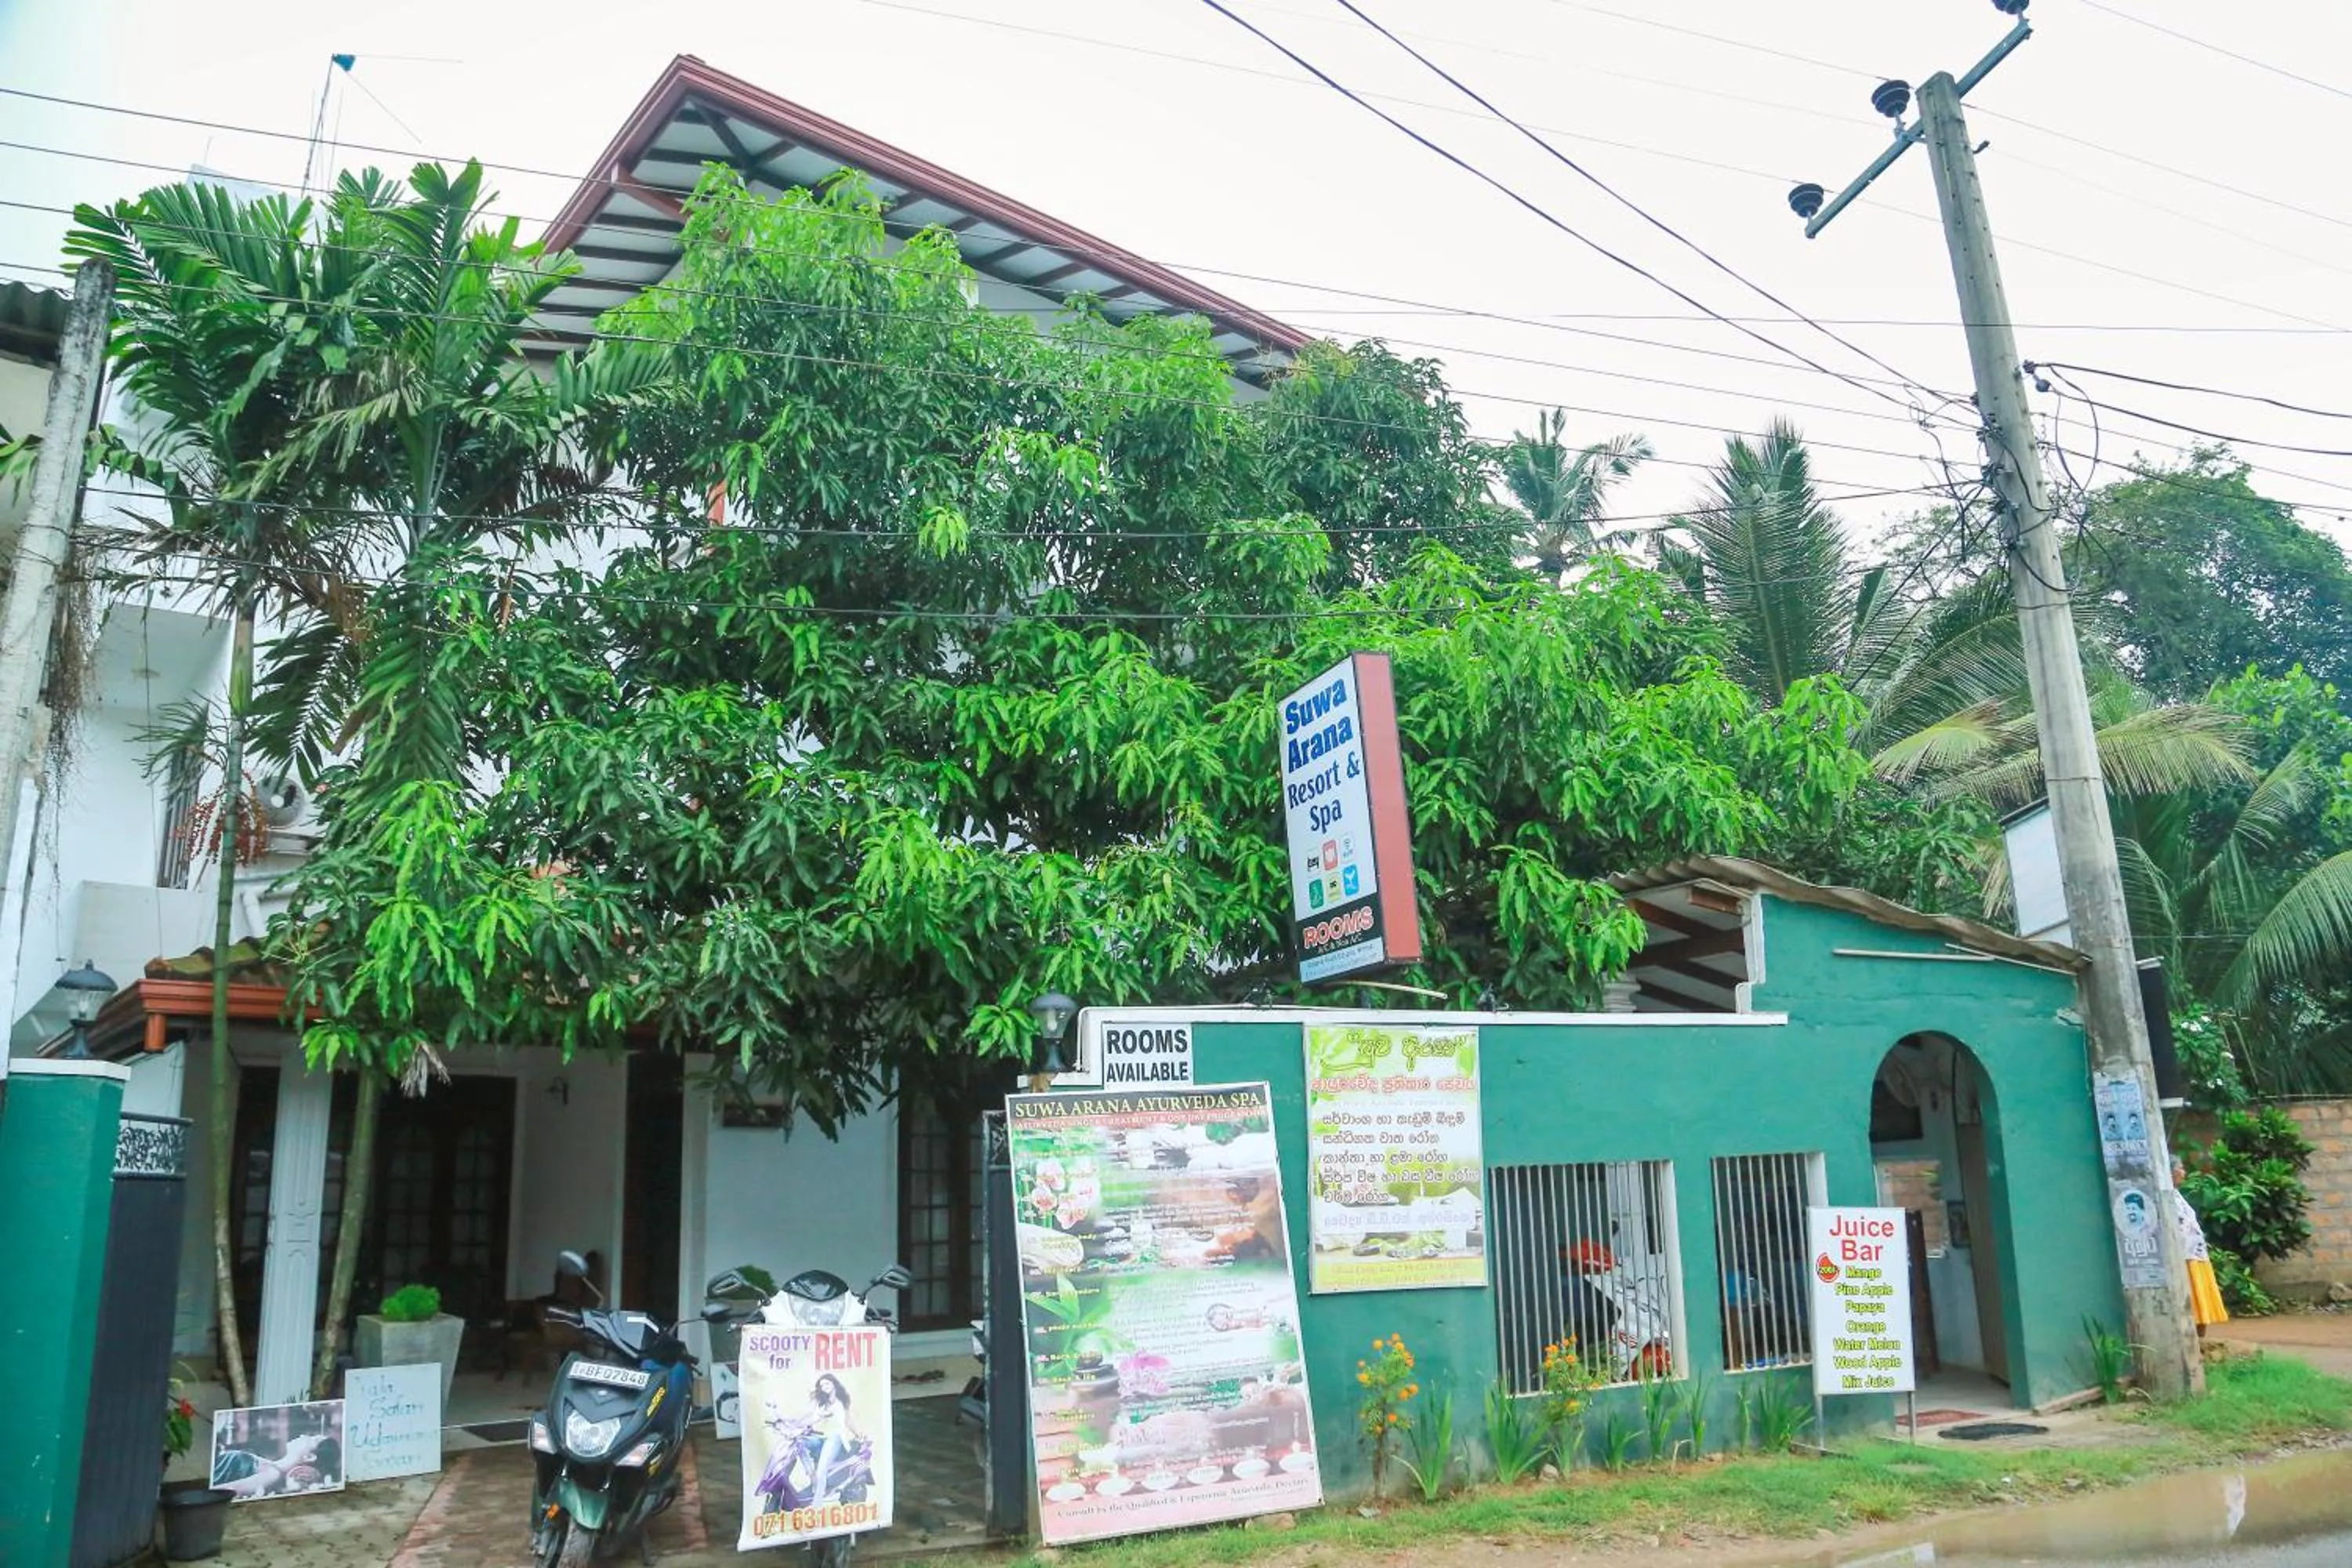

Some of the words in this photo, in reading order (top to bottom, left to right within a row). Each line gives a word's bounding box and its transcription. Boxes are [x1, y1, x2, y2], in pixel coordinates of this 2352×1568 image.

[1285, 678, 1347, 735] Suwa
[1288, 714, 1354, 773] Arana
[1287, 763, 1341, 809] Resort
[1346, 751, 1360, 779] &
[1310, 797, 1342, 835] Spa
[1303, 906, 1374, 949] ROOMS
[1107, 1029, 1188, 1054] ROOMS
[1106, 1062, 1189, 1083] AVAILABLE
[1015, 1102, 1067, 1117] SUWA
[1071, 1099, 1131, 1116] ARANA
[1136, 1094, 1228, 1112] AYURVEDA
[1230, 1092, 1261, 1106] SPA
[1829, 1215, 1895, 1237] Juice
[1842, 1240, 1883, 1261] Bar
[1846, 1265, 1882, 1280] Mango
[1835, 1283, 1860, 1295] Pine
[1861, 1283, 1894, 1298] Apple
[1845, 1300, 1886, 1316] Papaya
[1846, 1320, 1886, 1334] Orange
[750, 1335, 811, 1352] SCOOTY
[815, 1332, 877, 1370] RENT
[1833, 1338, 1866, 1350] Water
[1867, 1338, 1901, 1350] Melon
[769, 1353, 791, 1370] for
[1833, 1356, 1867, 1369] Wood
[1869, 1355, 1902, 1370] Apple
[1842, 1375, 1863, 1388] Mix
[1865, 1375, 1895, 1388] Juice
[793, 1502, 878, 1531] 6316801
